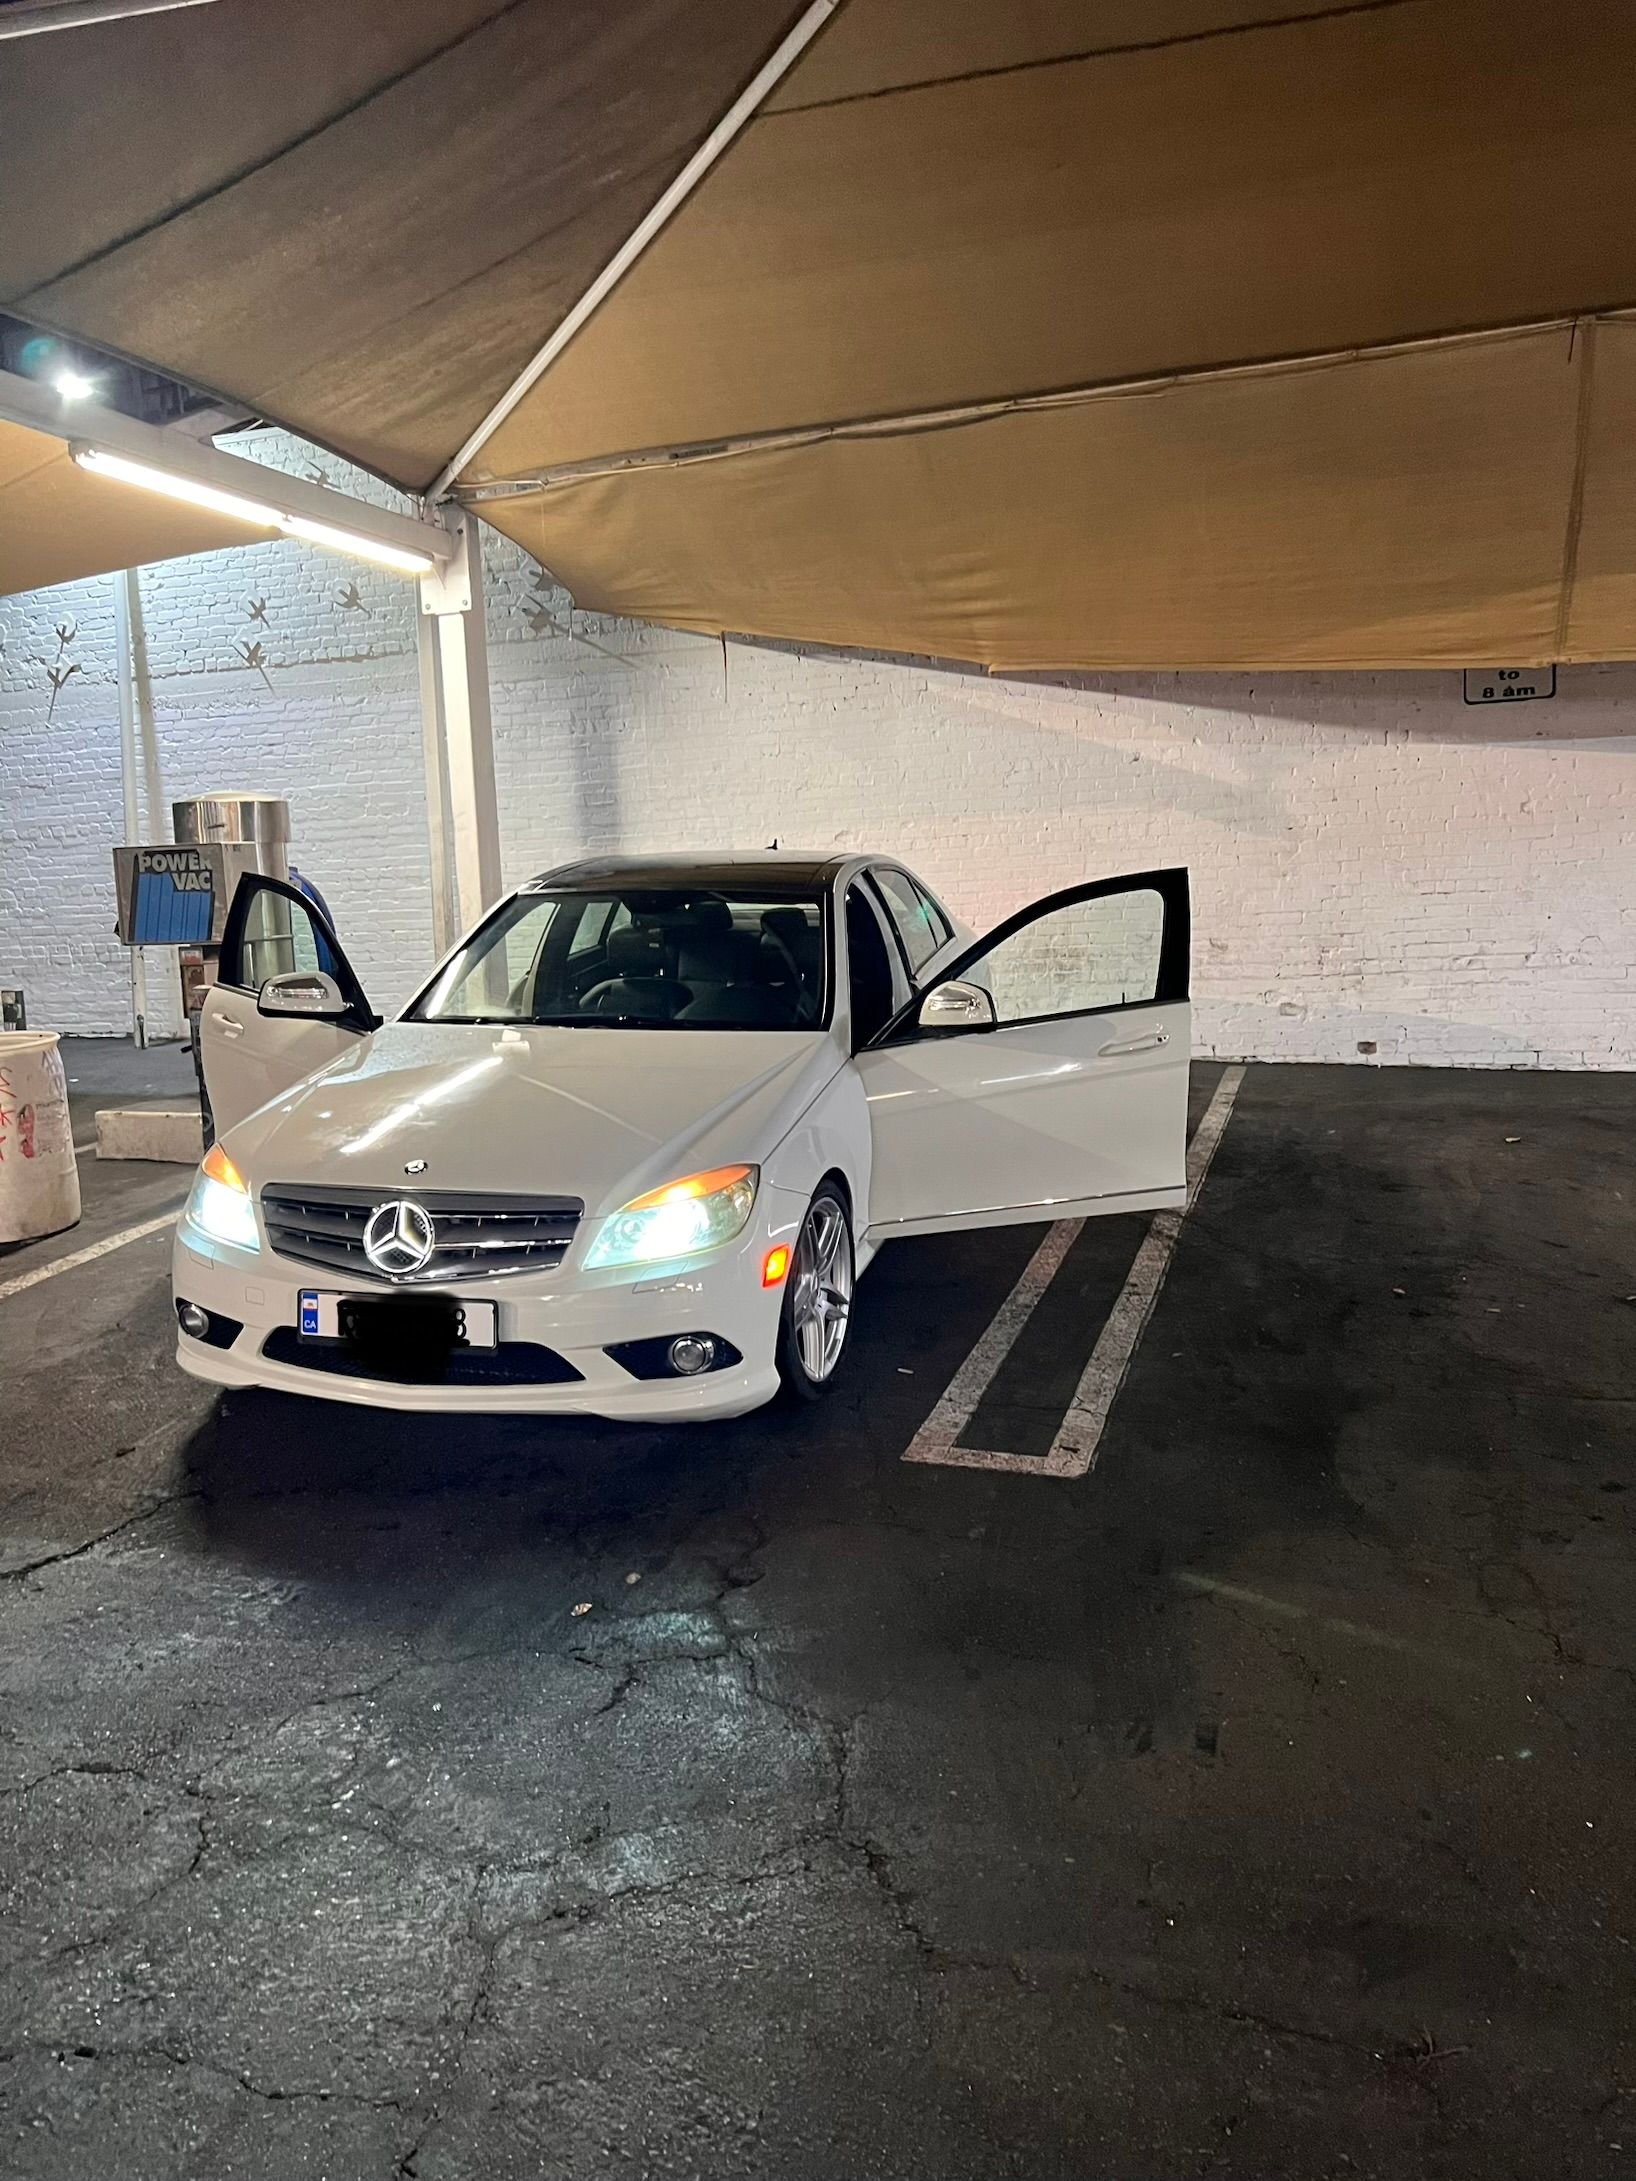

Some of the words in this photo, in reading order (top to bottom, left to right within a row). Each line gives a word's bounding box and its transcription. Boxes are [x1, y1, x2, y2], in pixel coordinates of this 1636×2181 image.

[1498, 670, 1520, 680] to
[1482, 687, 1494, 698] 8
[1502, 686, 1536, 697] am
[139, 852, 213, 872] POWER
[171, 871, 212, 891] VAC
[304, 1319, 317, 1329] CA
